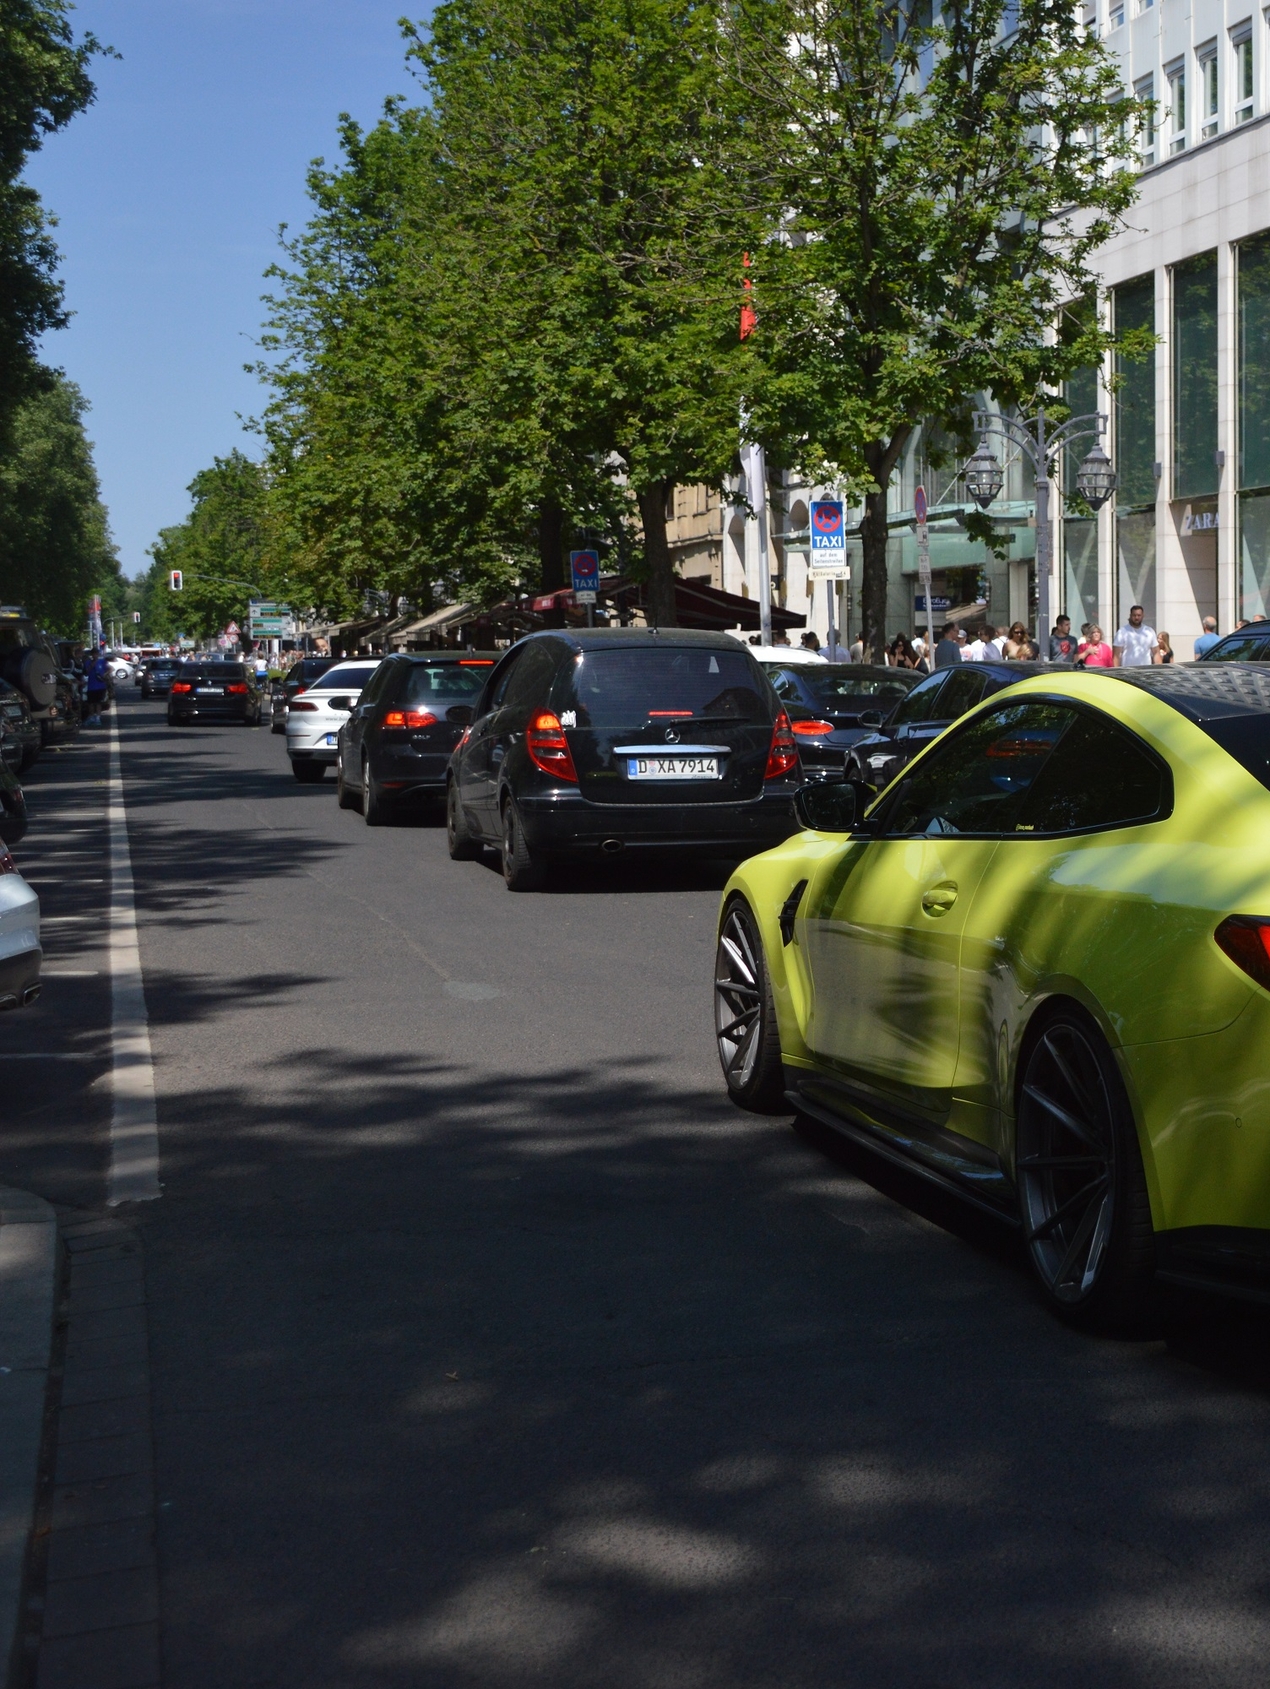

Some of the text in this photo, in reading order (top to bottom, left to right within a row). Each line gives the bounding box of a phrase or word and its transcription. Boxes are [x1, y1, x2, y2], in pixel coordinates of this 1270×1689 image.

[1185, 512, 1219, 530] ZARA
[814, 536, 842, 547] TAXI
[575, 579, 598, 588] TAXI
[638, 760, 648, 774] D
